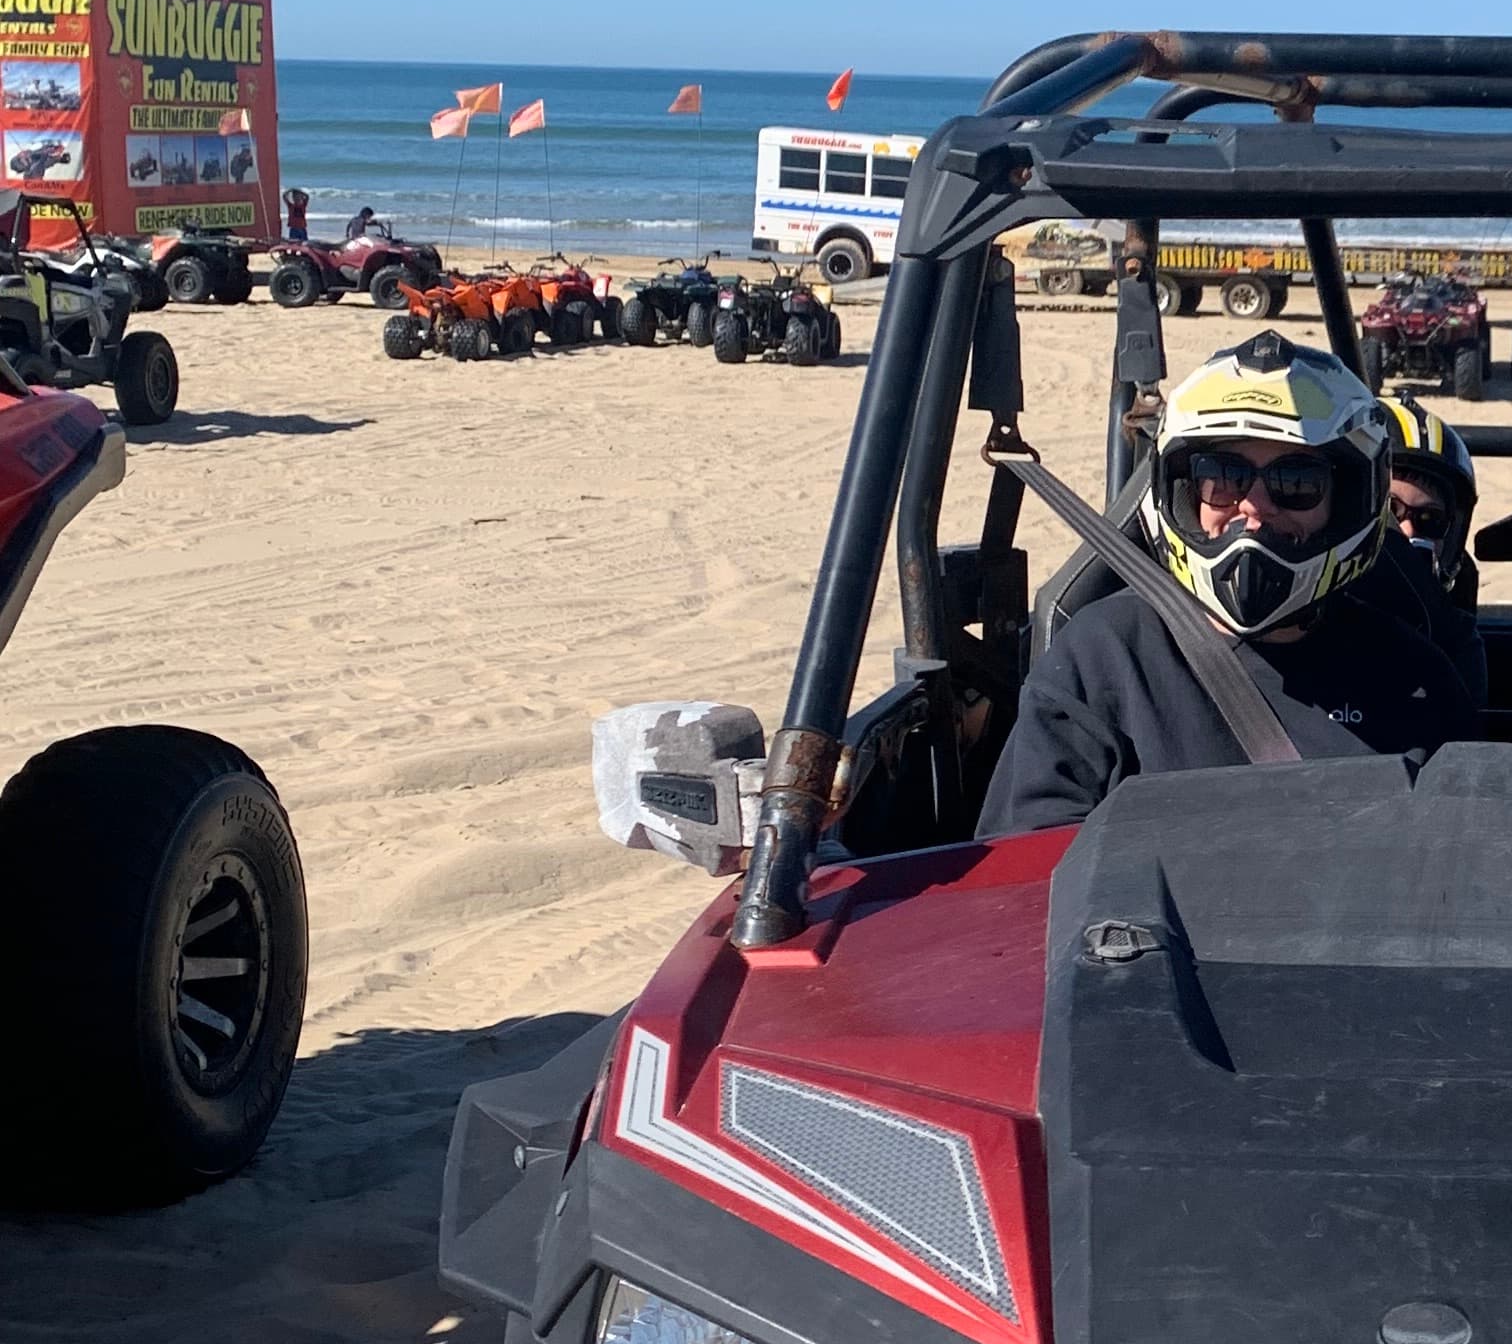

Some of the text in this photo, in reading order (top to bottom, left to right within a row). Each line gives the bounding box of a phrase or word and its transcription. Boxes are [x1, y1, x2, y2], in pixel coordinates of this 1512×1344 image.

[3, 42, 48, 55] FAMILY
[132, 107, 149, 128] THE
[151, 108, 194, 129] ULTIMATE
[205, 207, 227, 225] RIDE
[228, 205, 252, 223] NOW
[1328, 702, 1363, 724] alo
